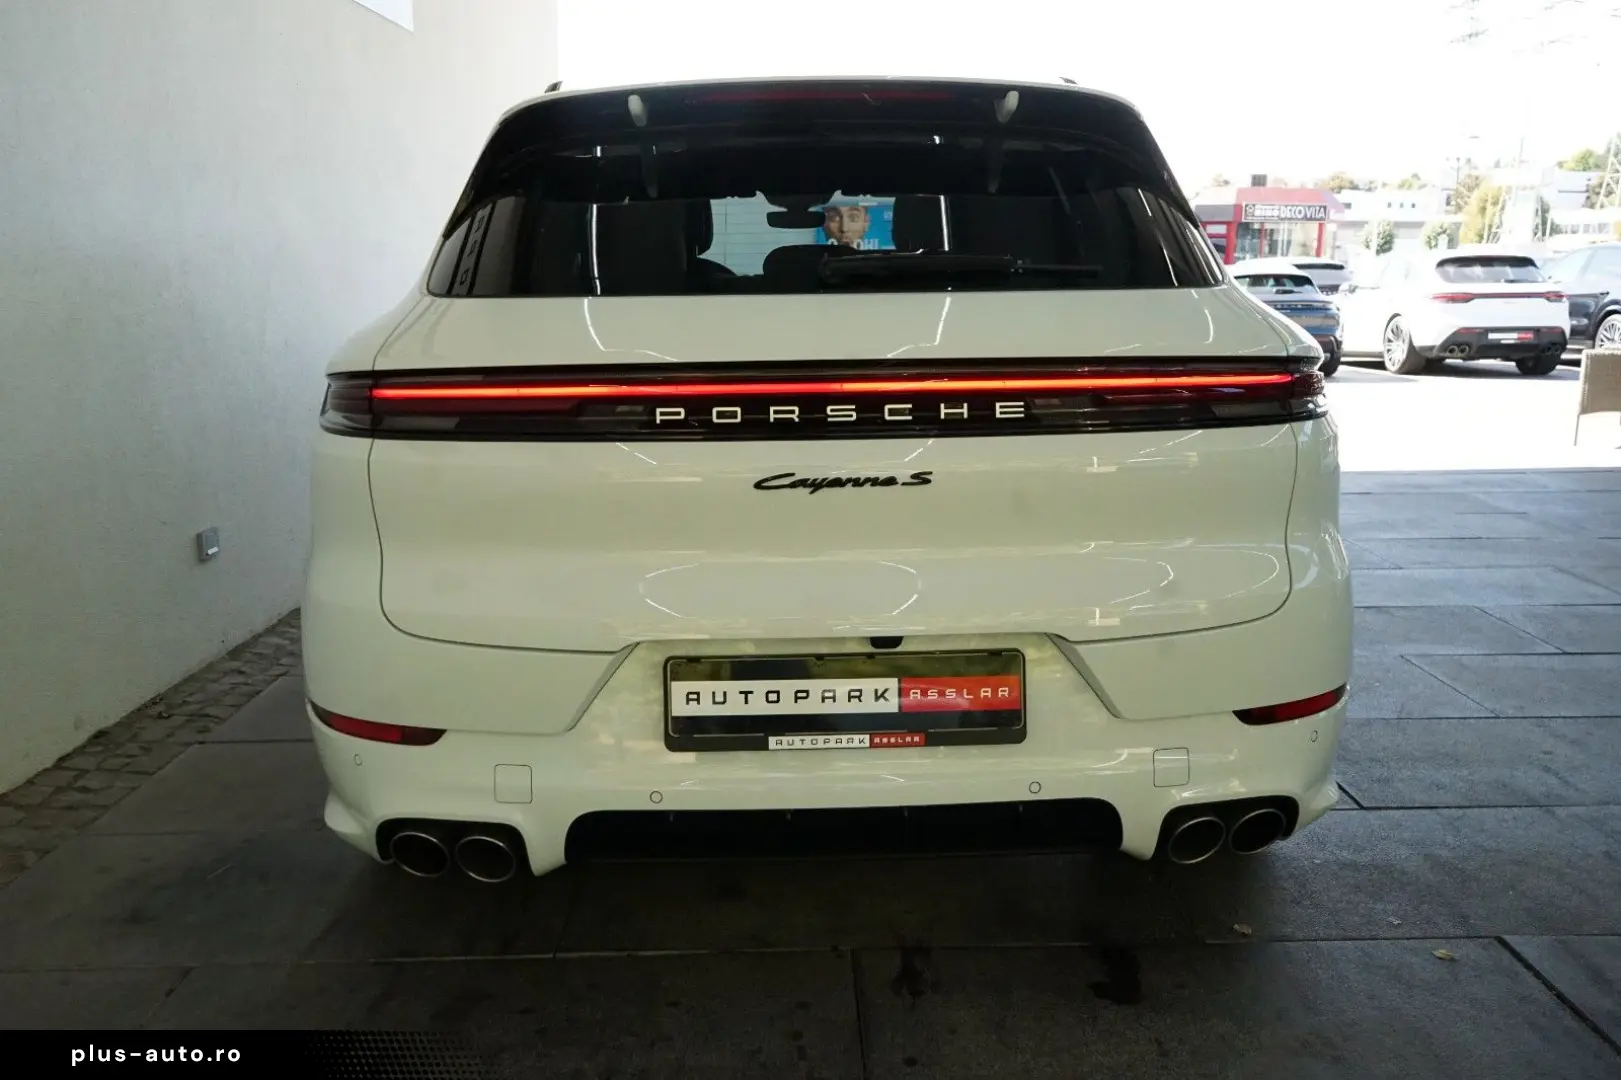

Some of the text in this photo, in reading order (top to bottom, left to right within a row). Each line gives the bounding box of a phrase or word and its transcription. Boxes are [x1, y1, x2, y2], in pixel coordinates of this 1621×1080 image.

[655, 401, 1025, 424] PORSCHE
[753, 471, 933, 495] Cayenne S
[685, 686, 1011, 706] AUTOPARK ASSLAR
[775, 736, 920, 747] AUTOPARK ASSLAR
